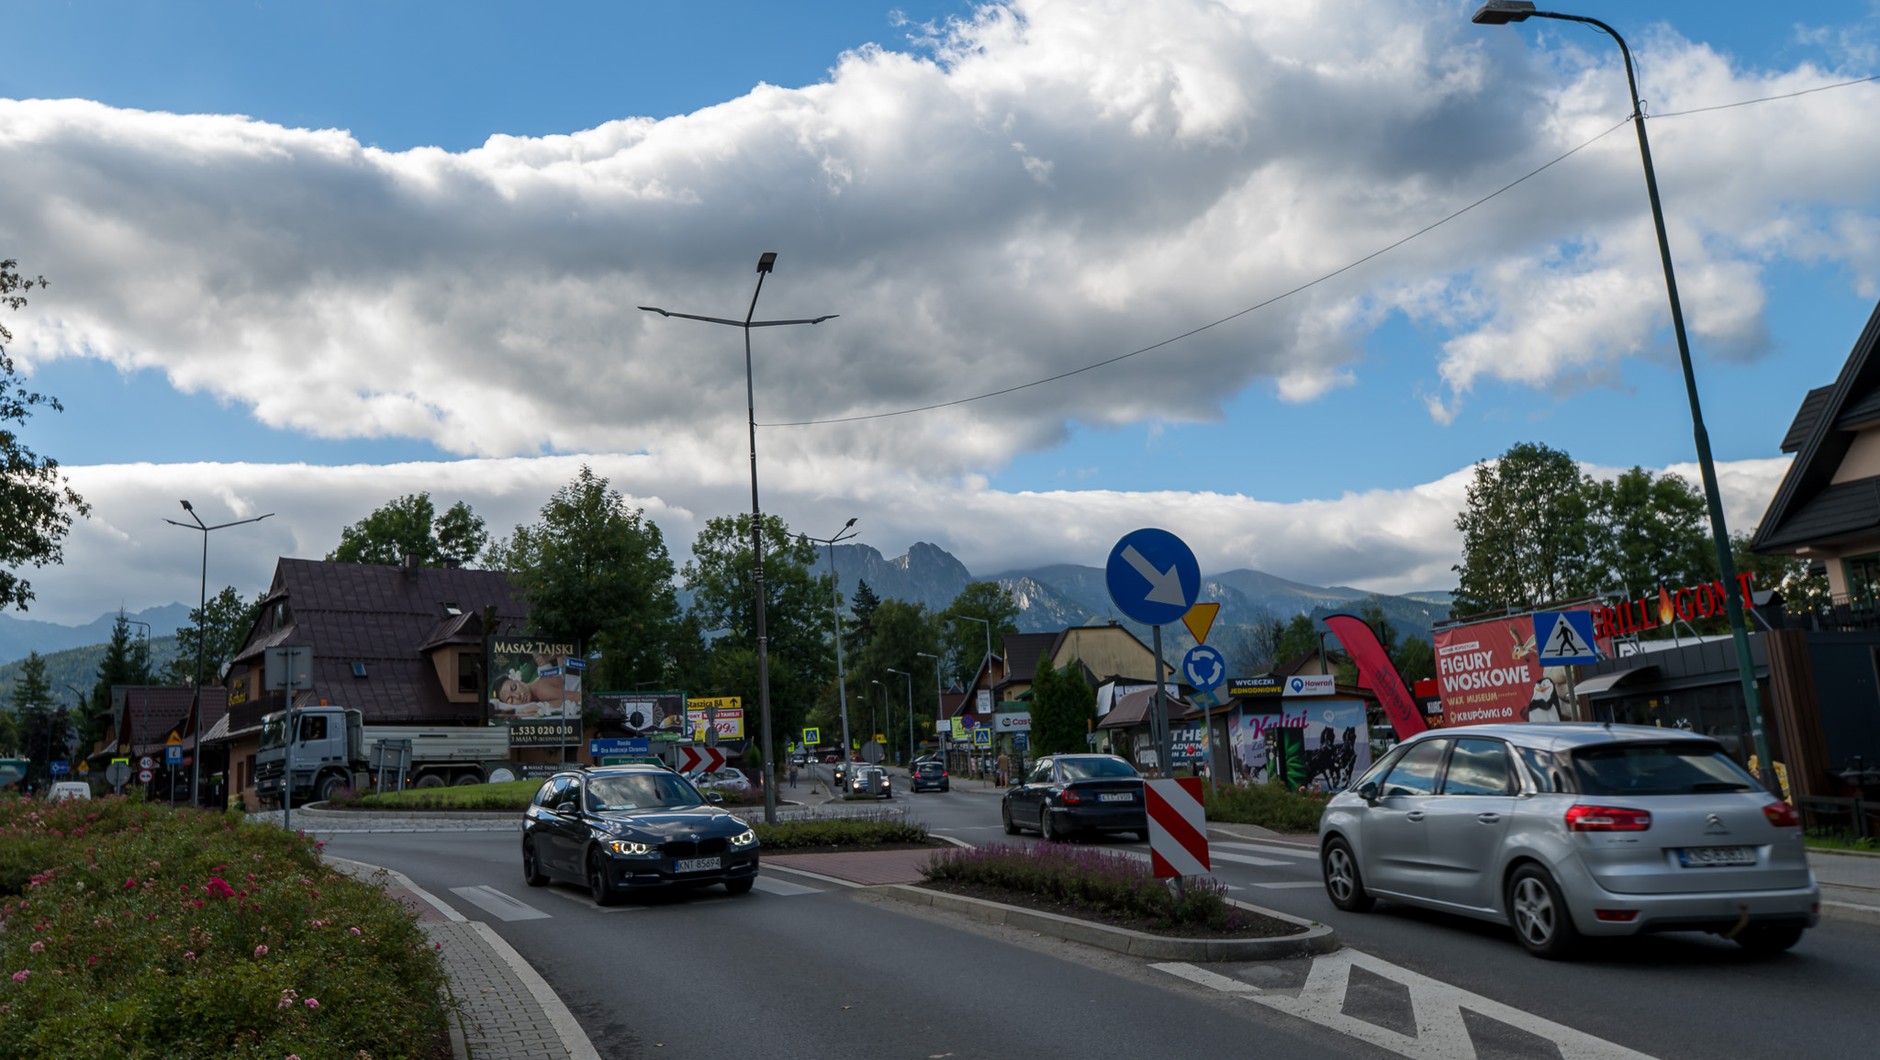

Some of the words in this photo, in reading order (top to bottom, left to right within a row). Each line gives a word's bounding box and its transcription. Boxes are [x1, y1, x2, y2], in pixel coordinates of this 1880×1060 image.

[1590, 598, 1659, 641] GRILL
[493, 641, 533, 654] MASAŻ
[535, 642, 574, 656] TAJSKI
[1440, 650, 1492, 675] FIGURY
[1443, 665, 1531, 693] WOSKOWE
[1230, 687, 1282, 695] JEDNODNIOWE
[1447, 697, 1464, 706] WAX
[1467, 692, 1498, 704] MUSEUM
[1458, 708, 1500, 722] KRUPÓWKI
[1501, 707, 1513, 717] 60
[537, 726, 554, 735] 020
[680, 861, 693, 870] KNT
